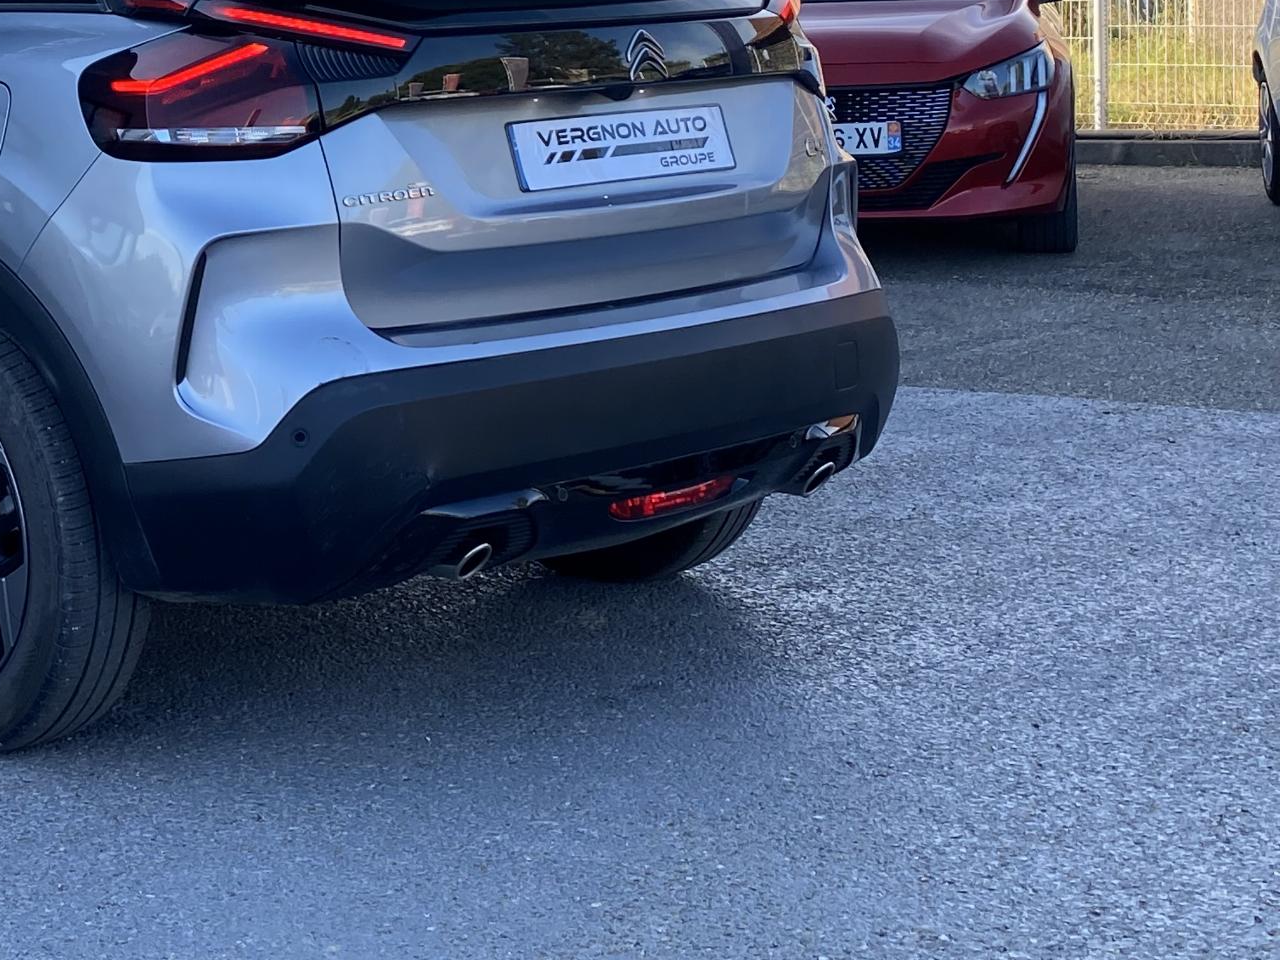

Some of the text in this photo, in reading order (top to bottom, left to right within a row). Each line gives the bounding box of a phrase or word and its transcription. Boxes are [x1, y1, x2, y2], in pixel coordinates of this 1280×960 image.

[536, 115, 708, 148] VERGNON AUTO
[660, 151, 716, 168] GROUPE
